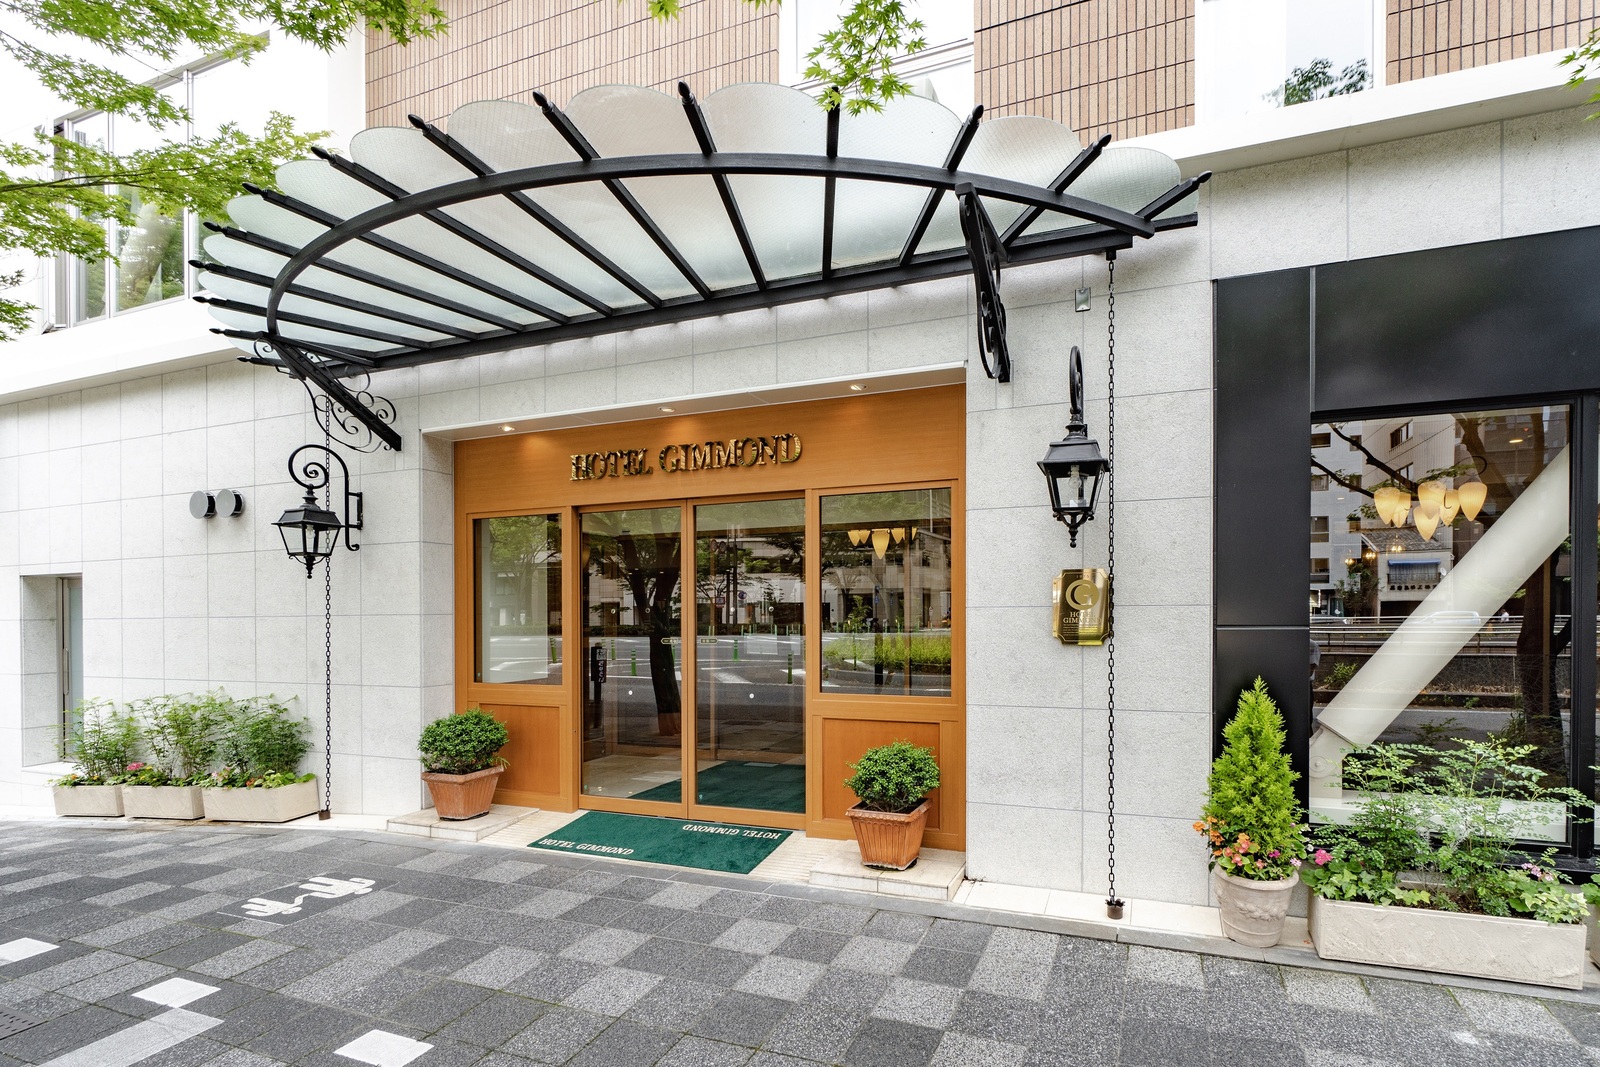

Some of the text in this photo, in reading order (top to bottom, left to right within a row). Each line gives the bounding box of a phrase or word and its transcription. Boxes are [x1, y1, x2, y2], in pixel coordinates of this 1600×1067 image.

[569, 433, 803, 481] HOTEL GIMMOND
[682, 824, 782, 840] HOTEL GIMMOND
[538, 838, 635, 855] HOTEL GIMMOND
